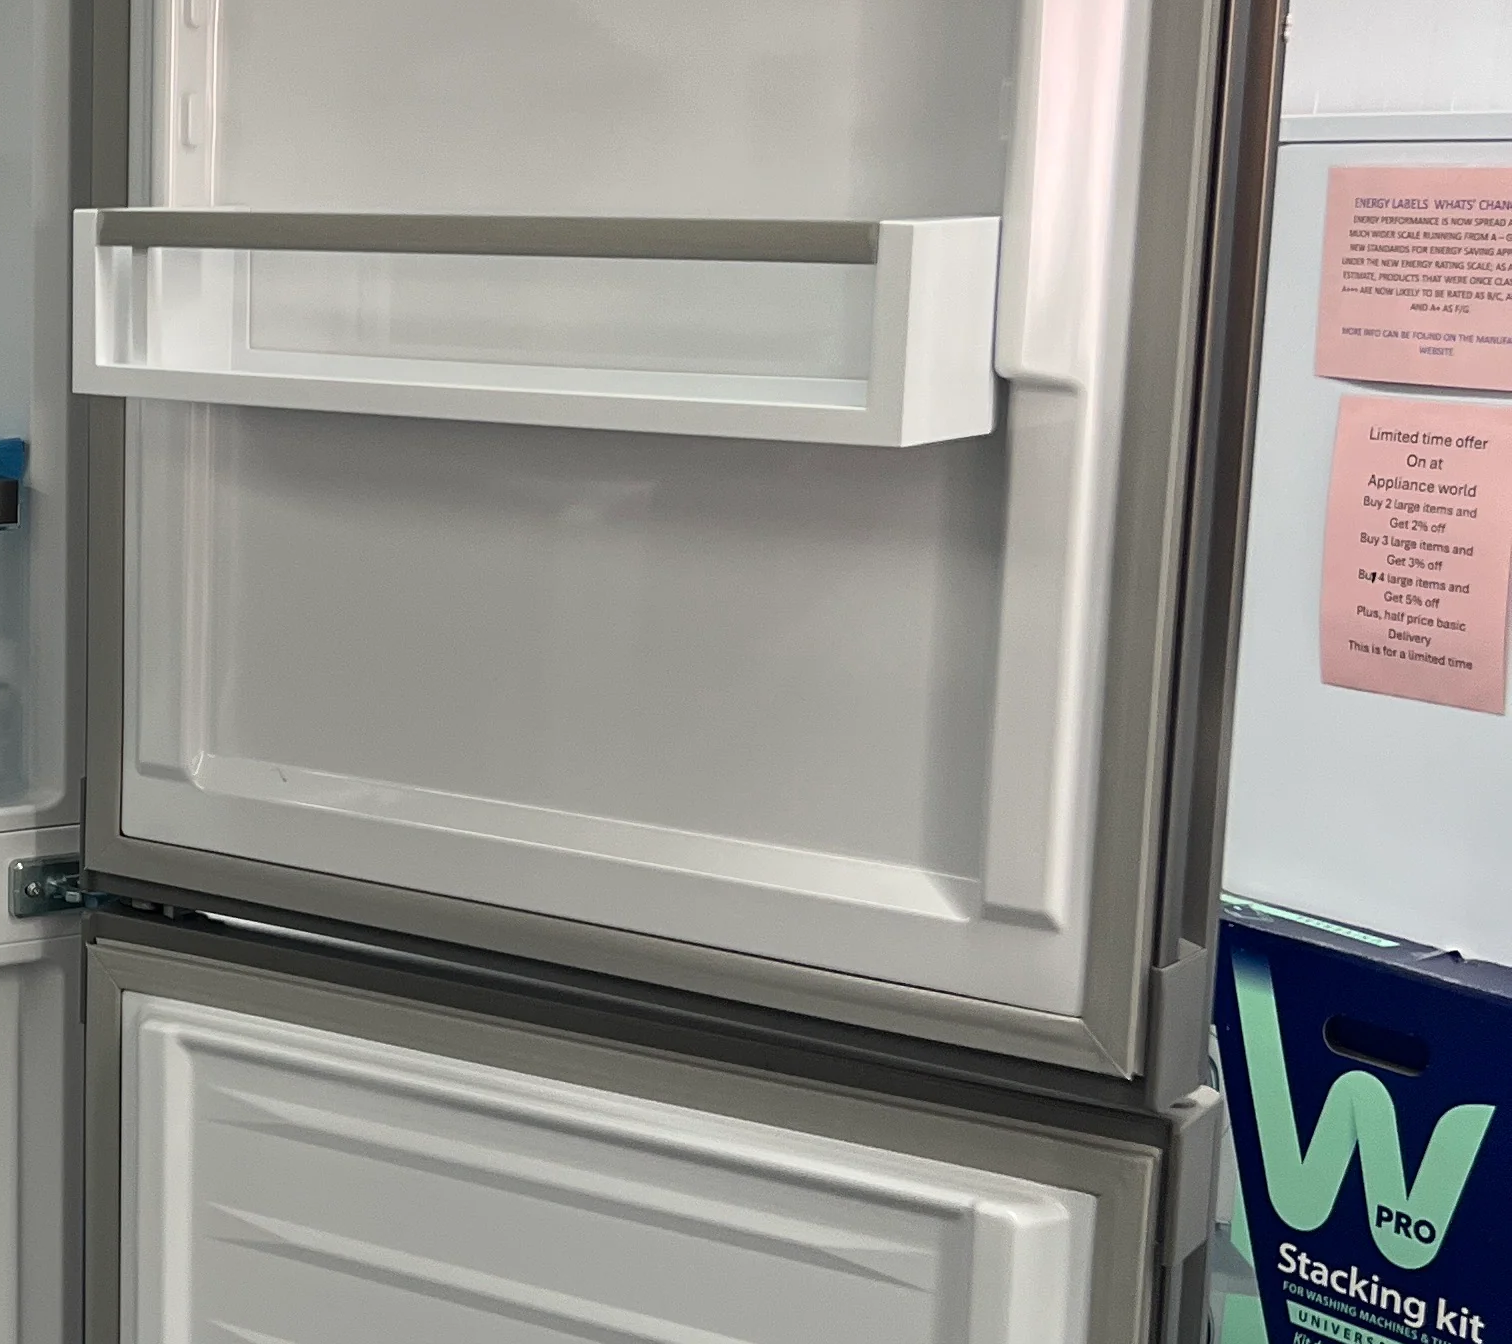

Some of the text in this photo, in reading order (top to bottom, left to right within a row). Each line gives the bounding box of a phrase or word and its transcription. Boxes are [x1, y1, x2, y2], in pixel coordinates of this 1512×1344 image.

[1355, 198, 1390, 209] ENERGY
[1392, 198, 1428, 210] LABELS
[1353, 216, 1379, 225] ENERGY
[1381, 216, 1439, 226] PERFORMANCE
[1442, 217, 1449, 226] IS
[1451, 217, 1473, 226] NOW
[1475, 218, 1506, 227] SPREAD
[1371, 230, 1396, 239] WIDER
[1397, 230, 1420, 239] SCALE
[1423, 231, 1462, 241] RUNNING
[1464, 232, 1489, 241] FROM
[1350, 244, 1365, 252] NEW
[1367, 244, 1410, 253] STANDARDS
[1412, 245, 1428, 254] FOR
[1430, 246, 1462, 255] ENERGY
[1464, 246, 1493, 256] SAVING
[1341, 258, 1364, 266] UNDER
[1366, 258, 1379, 267] THE
[1381, 259, 1399, 268] NEW
[1401, 259, 1433, 269] ENERGY
[1435, 260, 1464, 270] RATING
[1495, 262, 1506, 272] AS
[1378, 272, 1419, 283] PRODUCTS
[1422, 273, 1442, 283] THAT
[1444, 274, 1468, 285] WERE
[1469, 275, 1493, 286] ONCE
[1360, 286, 1373, 295] ARE
[1374, 287, 1394, 296] NOW
[1396, 288, 1420, 297] LIKELY
[1422, 289, 1433, 298] TO
[1435, 289, 1445, 298] BE
[1446, 290, 1473, 300] RATED
[1410, 303, 1429, 312] AND
[1342, 327, 1362, 336] MORE
[1382, 329, 1399, 339] CAN
[1401, 330, 1410, 339] BE
[1412, 331, 1442, 342] FOUND
[1458, 333, 1474, 343] THE
[1419, 346, 1454, 356] WEBSITE
[1369, 426, 1489, 450] Limited time offer
[1406, 453, 1444, 471] On at
[1368, 474, 1478, 498] Appliance world
[1363, 496, 1478, 519] Buy 2 large items and
[1389, 517, 1447, 534] Get 2% off
[1360, 532, 1474, 557] Buy 3 large items and
[1386, 554, 1443, 571] Get 3% off
[1377, 572, 1385, 582] 4
[1387, 573, 1413, 588] large
[1415, 576, 1446, 591] items
[1448, 583, 1470, 594] and
[1383, 591, 1440, 609] Get 5% off
[1356, 605, 1467, 632] Plus, half price basic
[1388, 628, 1432, 648] Delivery
[1348, 639, 1473, 671] This is for a limited time
[1375, 1204, 1436, 1245] PRO
[1277, 1242, 1427, 1329] Stacking
[1282, 1280, 1305, 1298] FOR
[1305, 1286, 1357, 1318] WASHING
[1358, 1309, 1418, 1341] MACHINES
